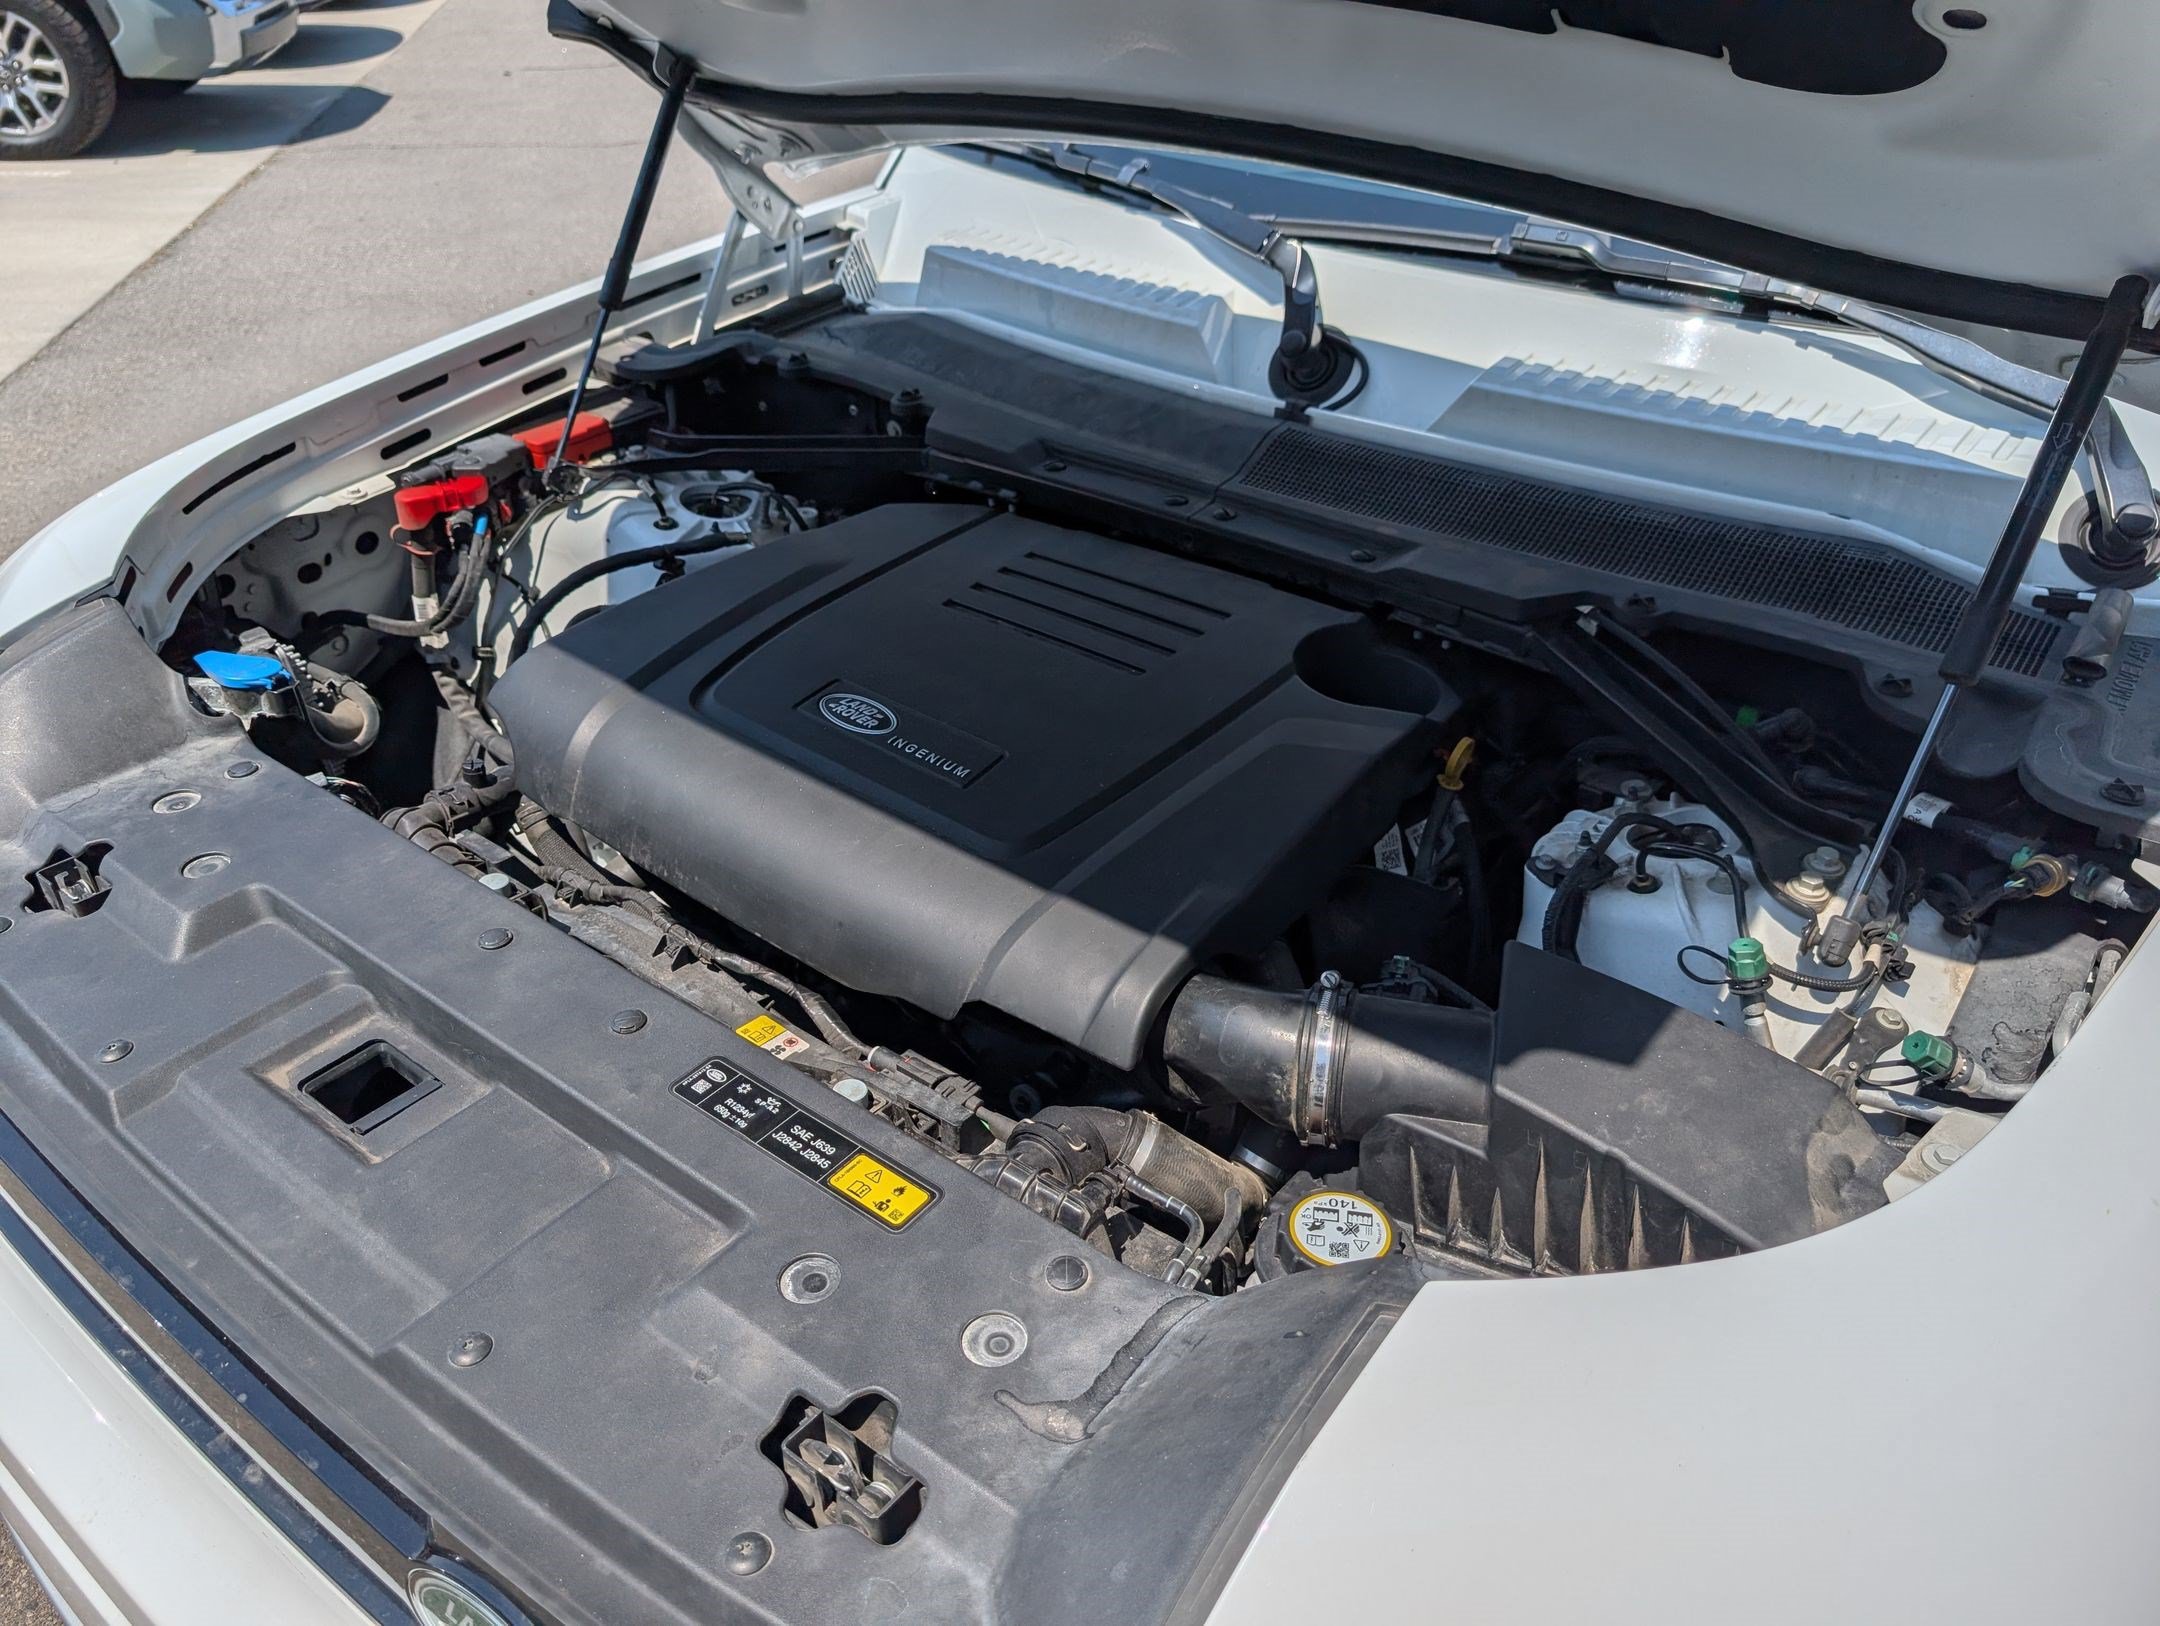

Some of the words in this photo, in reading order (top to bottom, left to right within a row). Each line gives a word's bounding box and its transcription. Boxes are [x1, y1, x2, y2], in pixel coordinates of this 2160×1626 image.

[832, 704, 880, 728] ROVER
[840, 698, 877, 716] LAND
[887, 735, 971, 778] INGENIUM
[713, 1103, 731, 1118] 650g
[723, 1097, 756, 1119] R1234yf
[771, 1131, 803, 1152] J2842
[799, 1148, 832, 1169] J2845
[790, 1124, 815, 1142] SAE
[810, 1138, 836, 1155] J639
[1328, 1197, 1358, 1210] 140
[1301, 1212, 1312, 1220] OK
